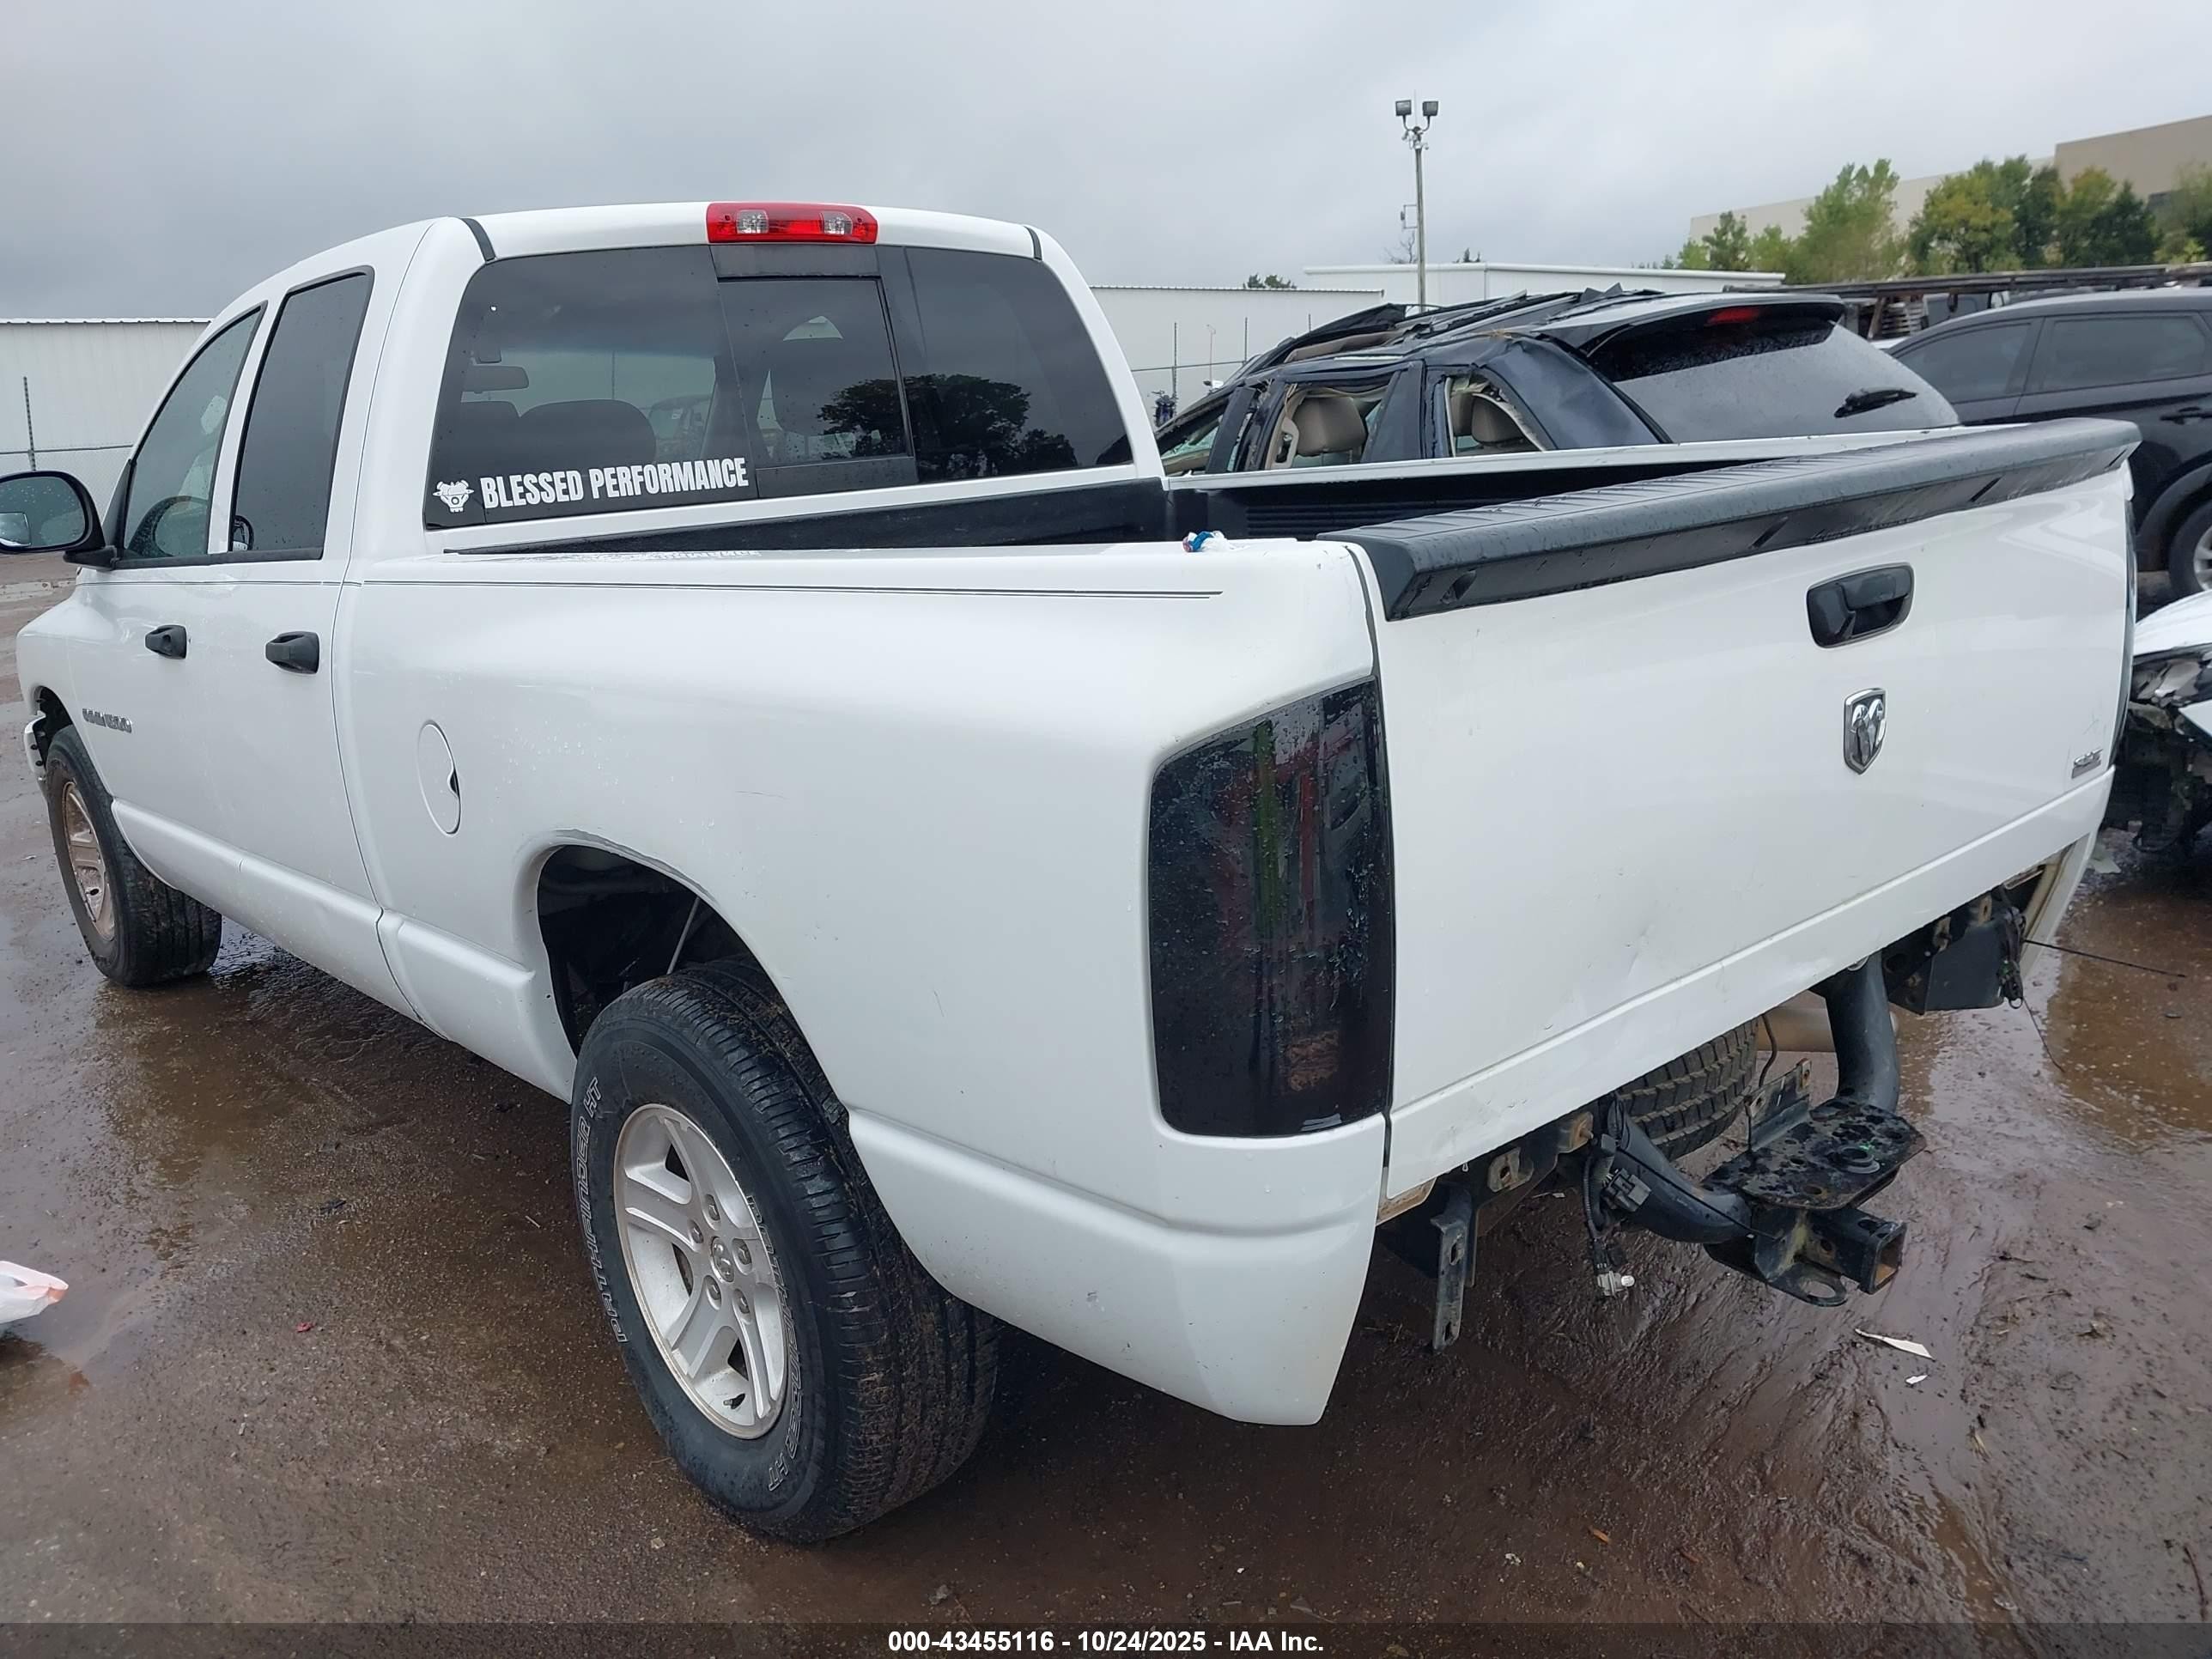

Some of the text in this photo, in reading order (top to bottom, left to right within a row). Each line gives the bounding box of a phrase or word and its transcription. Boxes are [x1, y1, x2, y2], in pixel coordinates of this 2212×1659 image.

[480, 457, 749, 509] BLESSED PERFORMANCE
[576, 1077, 628, 1344] PATHFINDER HT
[769, 1452, 789, 1492] HT
